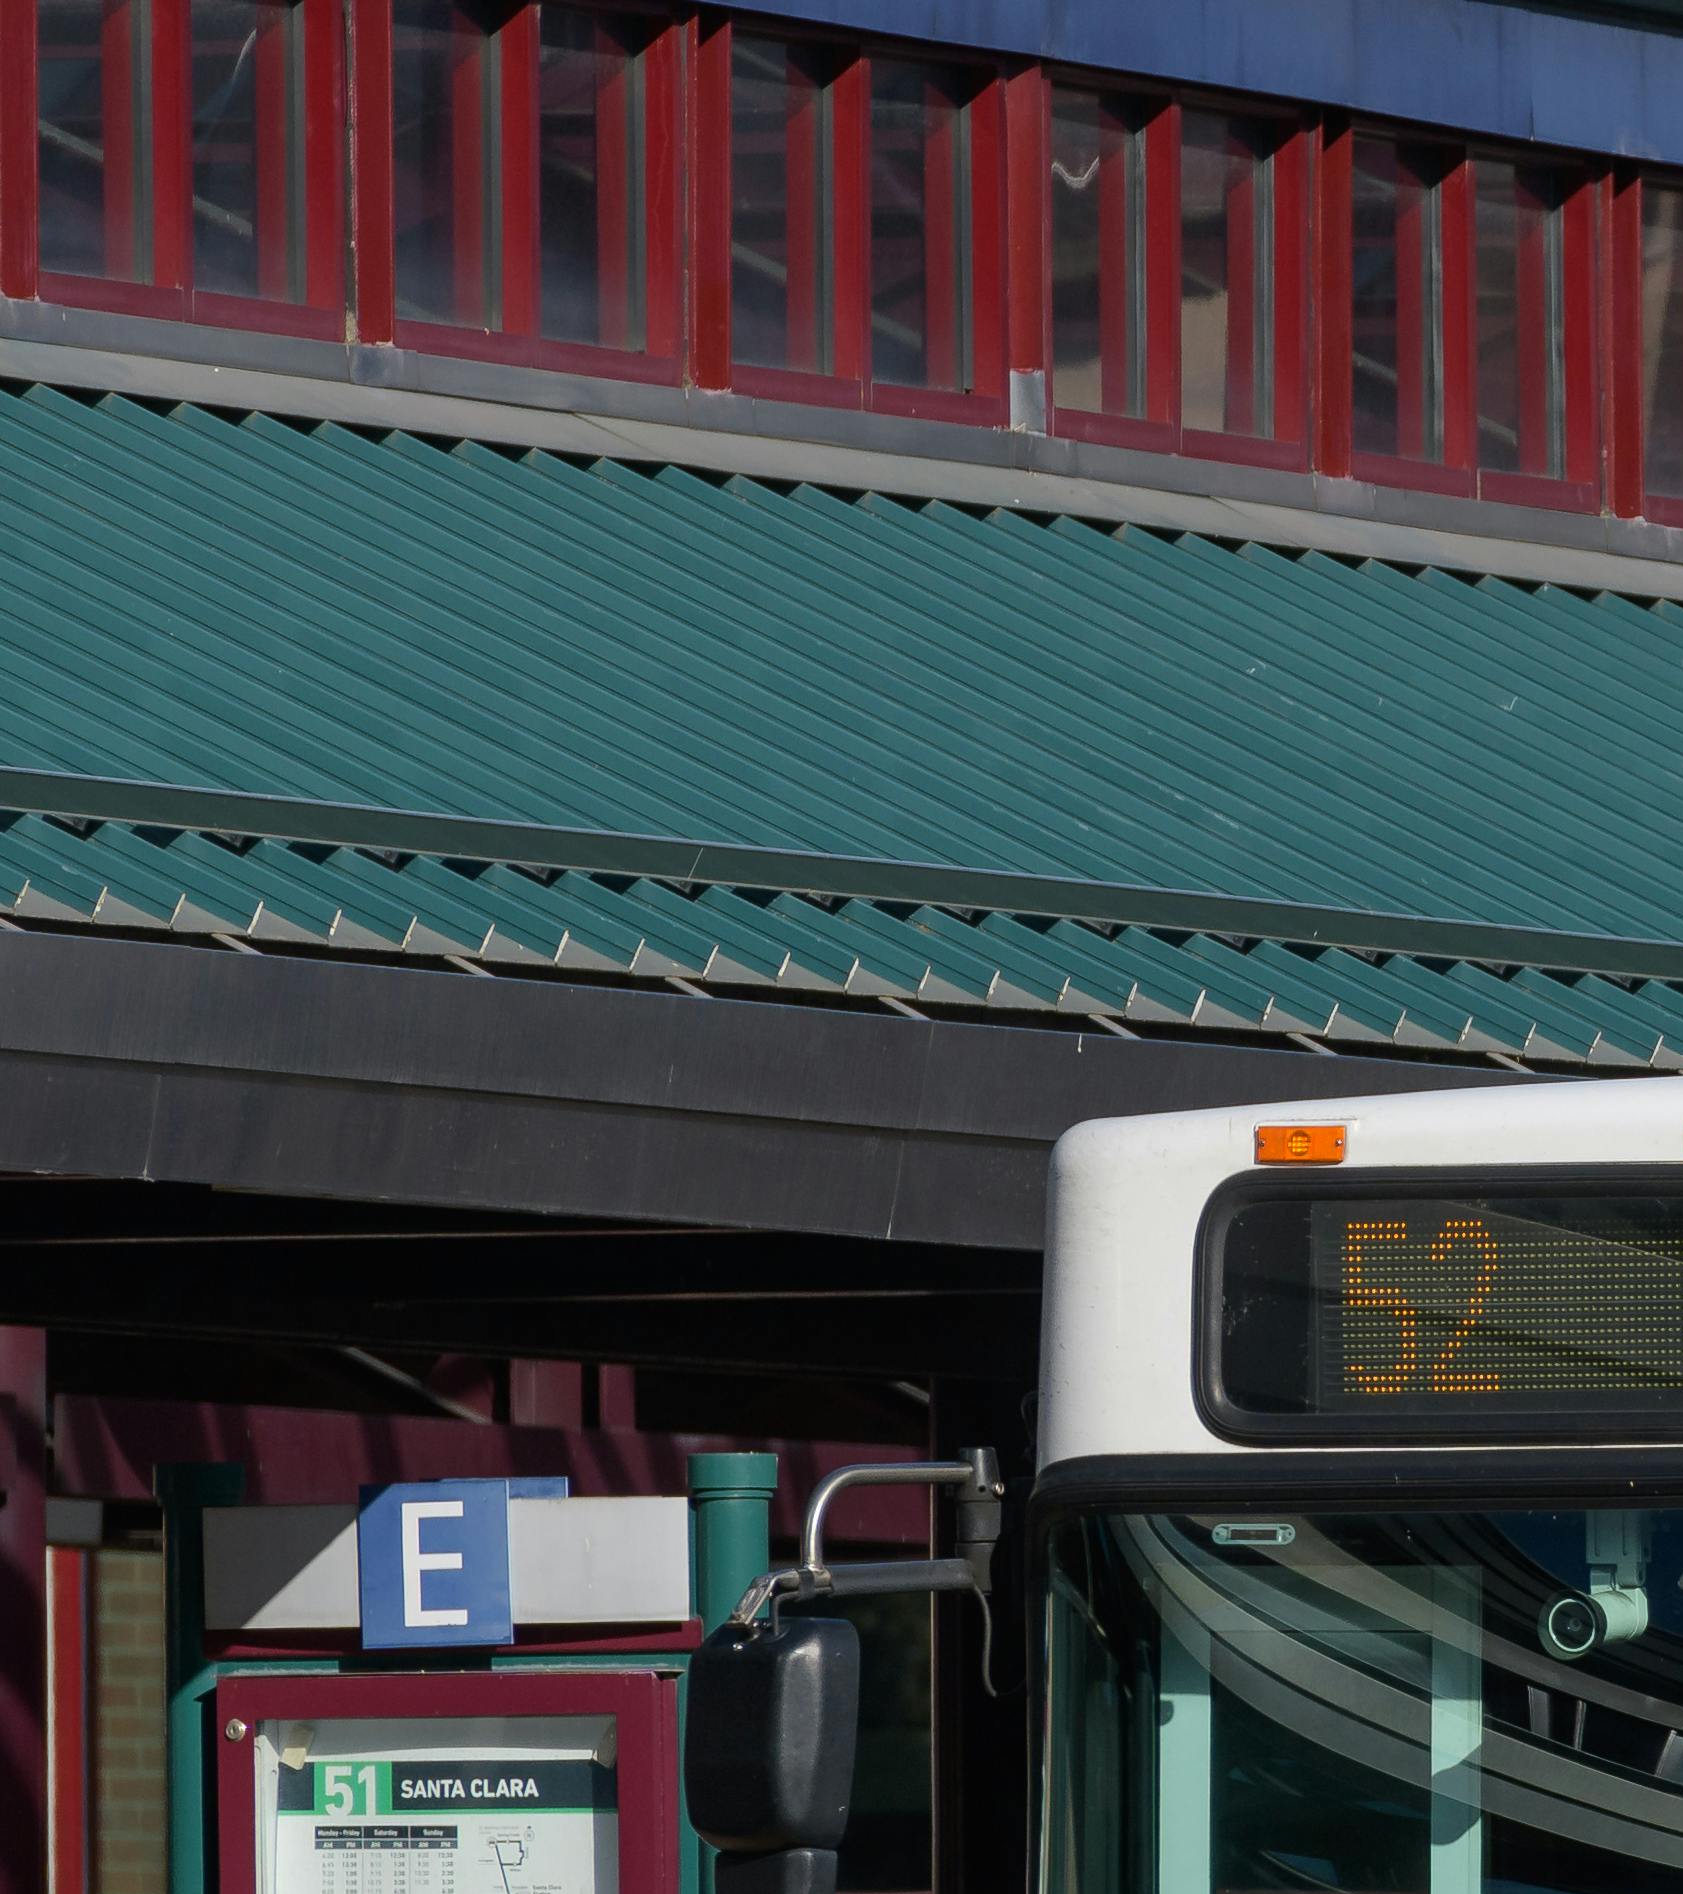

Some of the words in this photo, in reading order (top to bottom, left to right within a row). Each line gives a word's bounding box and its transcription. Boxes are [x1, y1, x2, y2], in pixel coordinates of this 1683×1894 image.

[1343, 1218, 1501, 1395] 52
[402, 1500, 469, 1628] E
[325, 1765, 378, 1816] 51
[400, 1779, 466, 1799] SANTA
[470, 1778, 539, 1798] CLARA
